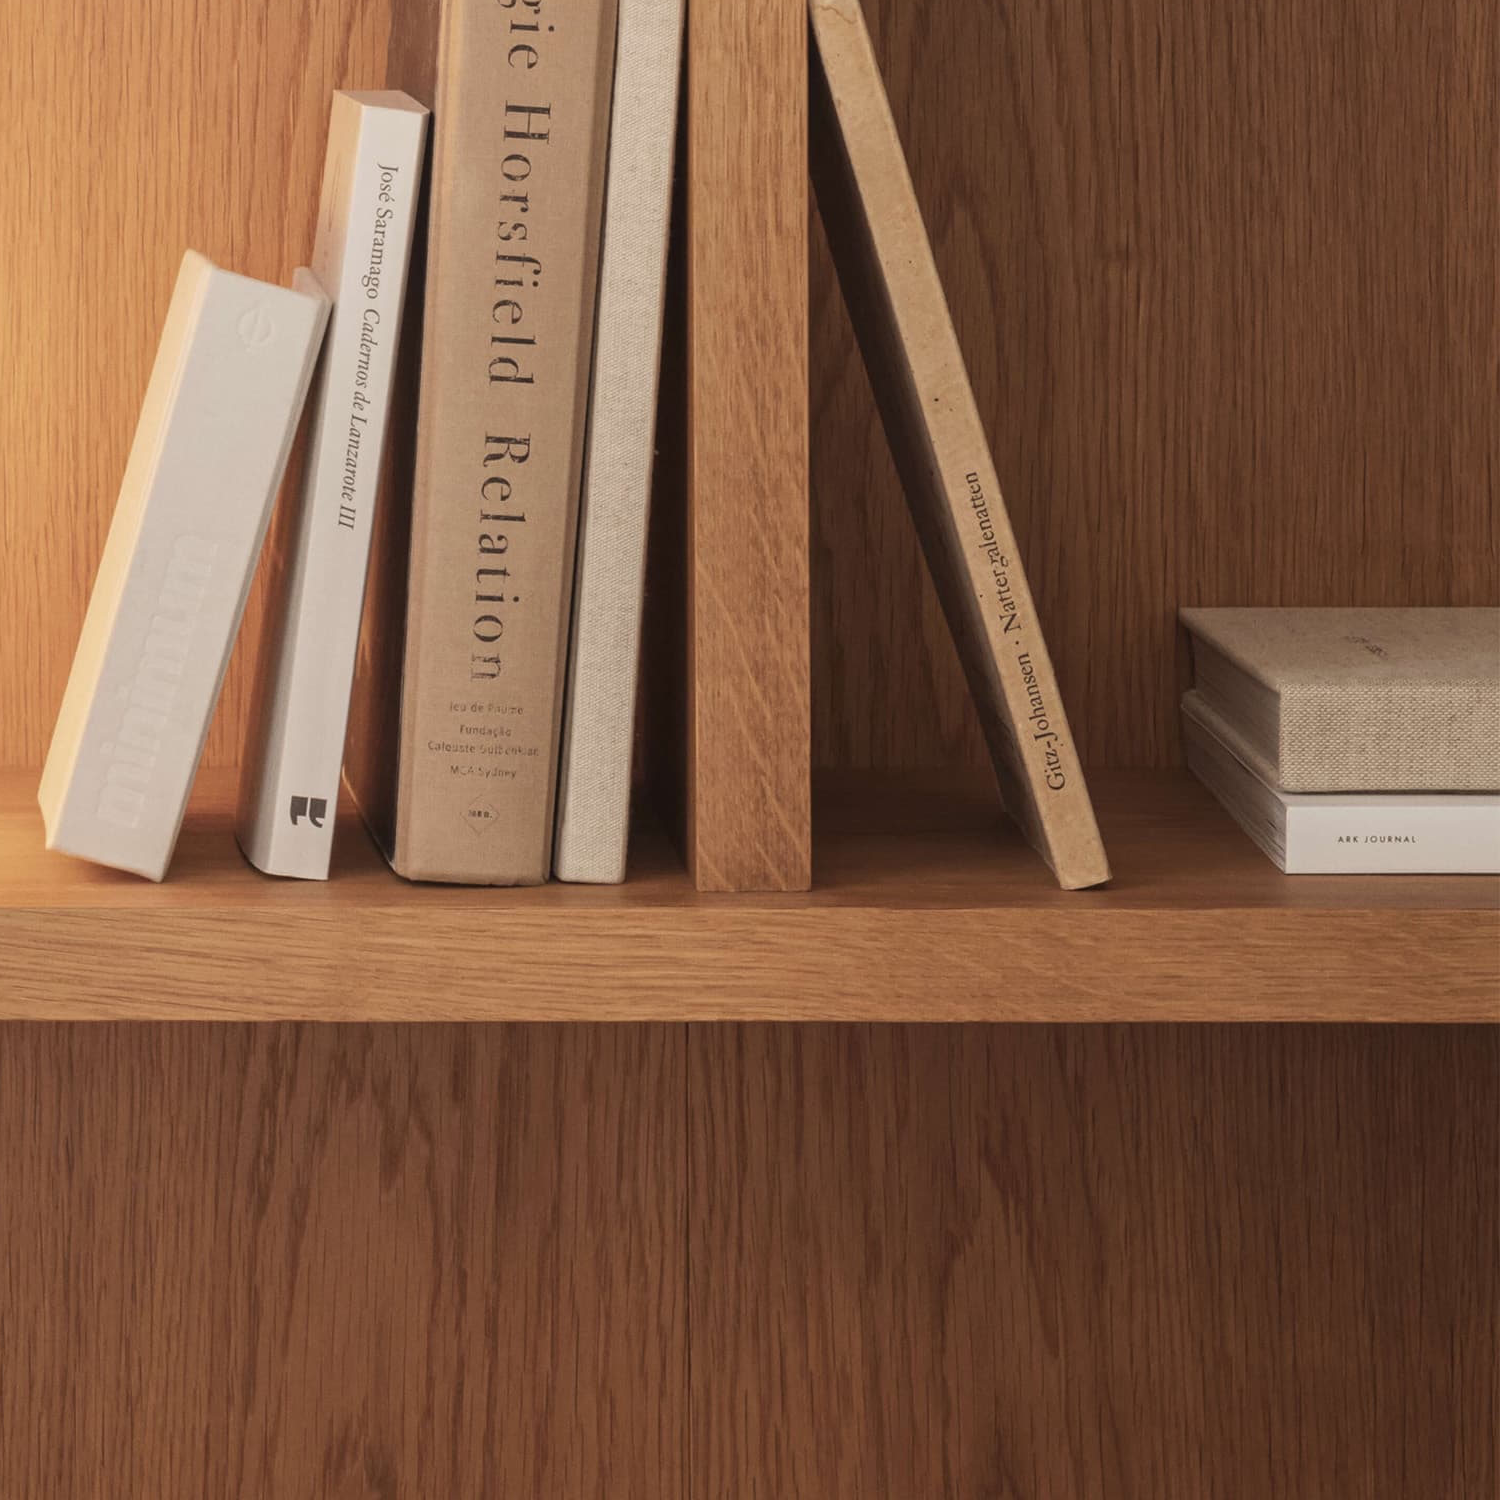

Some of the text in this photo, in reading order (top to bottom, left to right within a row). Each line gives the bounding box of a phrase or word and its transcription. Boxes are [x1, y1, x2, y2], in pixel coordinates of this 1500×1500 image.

[488, 101, 552, 387] Horsfield
[338, 163, 398, 530] José Saramago Cadernos de Lanzarote III
[470, 431, 532, 682] Relation
[470, 702, 484, 713] de
[1017, 652, 1065, 790] Gitz-Johansen
[1337, 835, 1417, 843] ARK JOURNAL
